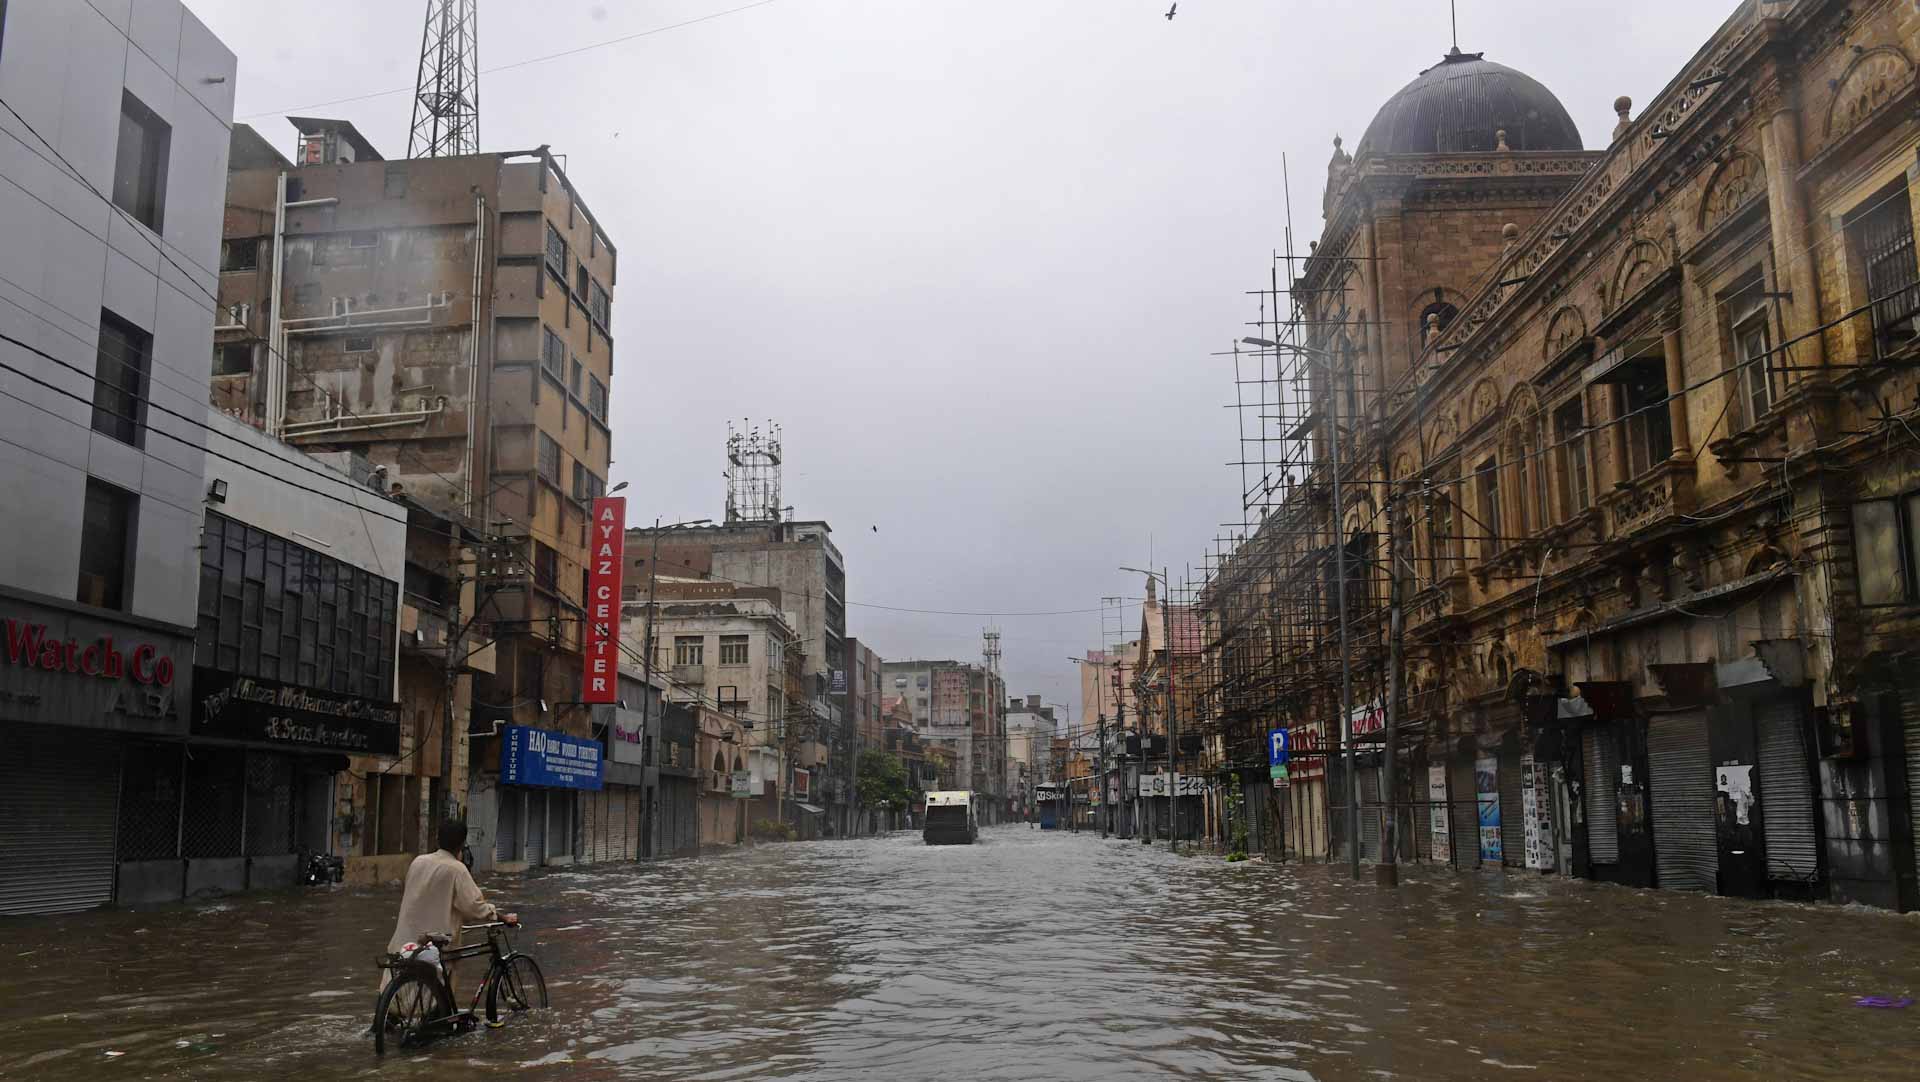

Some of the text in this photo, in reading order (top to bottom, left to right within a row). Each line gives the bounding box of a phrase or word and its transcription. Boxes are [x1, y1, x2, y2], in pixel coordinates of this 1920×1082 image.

[592, 507, 614, 692] AYAZ CENTER
[6, 618, 175, 687] Watch Co
[509, 729, 518, 781] FURNITURE
[529, 730, 547, 758] HAQ
[1272, 733, 1284, 759] P
